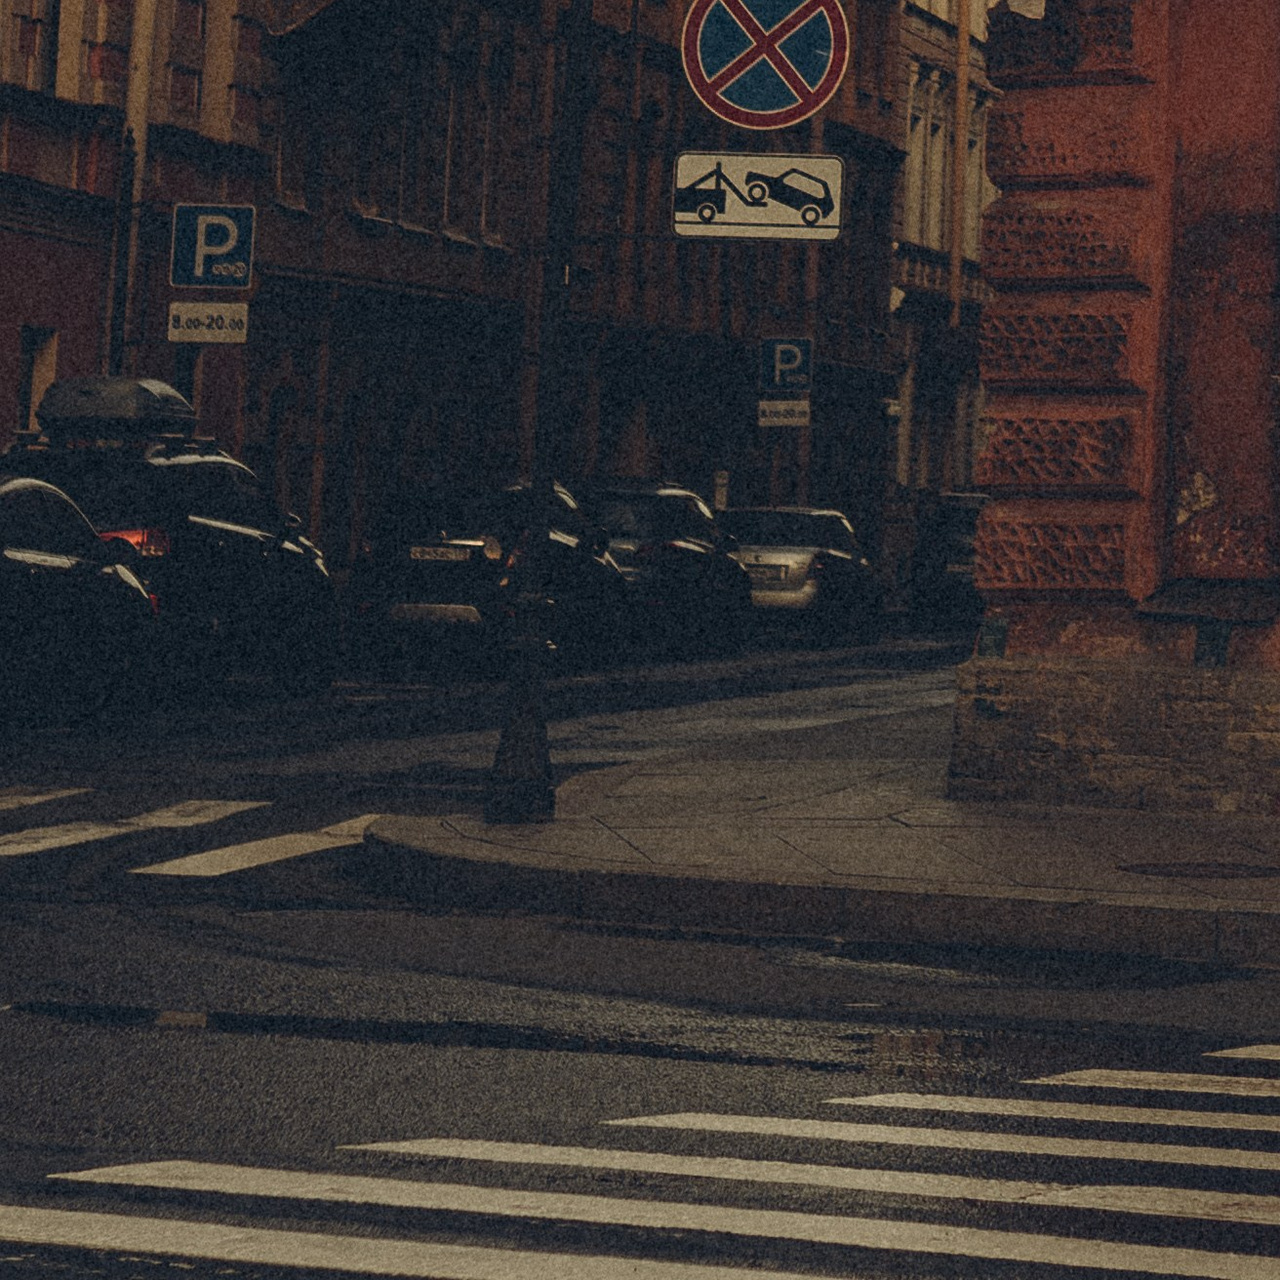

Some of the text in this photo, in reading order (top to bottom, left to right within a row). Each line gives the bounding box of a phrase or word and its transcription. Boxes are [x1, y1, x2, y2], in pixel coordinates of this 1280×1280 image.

[195, 215, 238, 277] P
[172, 314, 245, 331] 8.00-20.00
[775, 345, 802, 383] P
